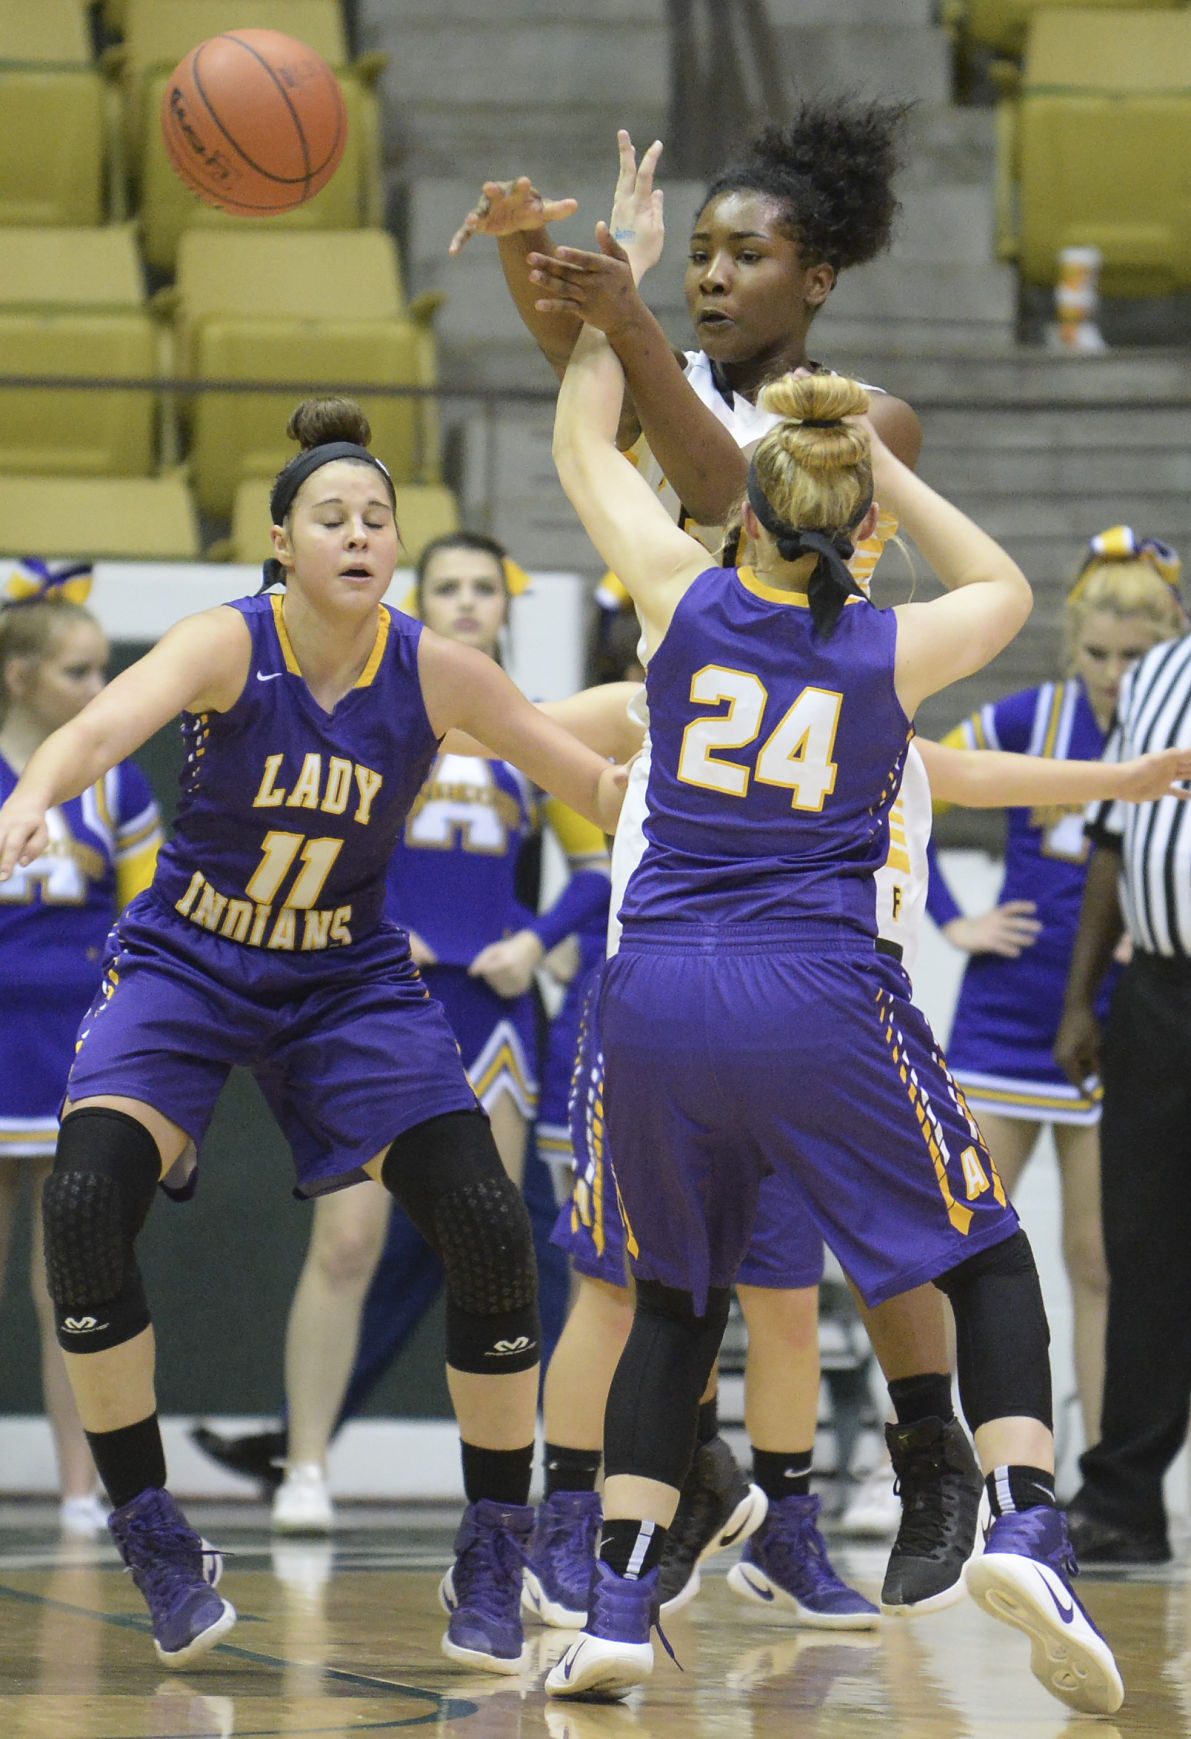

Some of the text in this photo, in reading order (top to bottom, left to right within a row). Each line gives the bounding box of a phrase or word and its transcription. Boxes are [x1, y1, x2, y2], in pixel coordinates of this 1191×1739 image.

[677, 664, 843, 812] 24
[253, 753, 383, 825] LADY
[245, 831, 345, 910] 11
[174, 870, 352, 951] INDIANS
[960, 1145, 990, 1201] A
